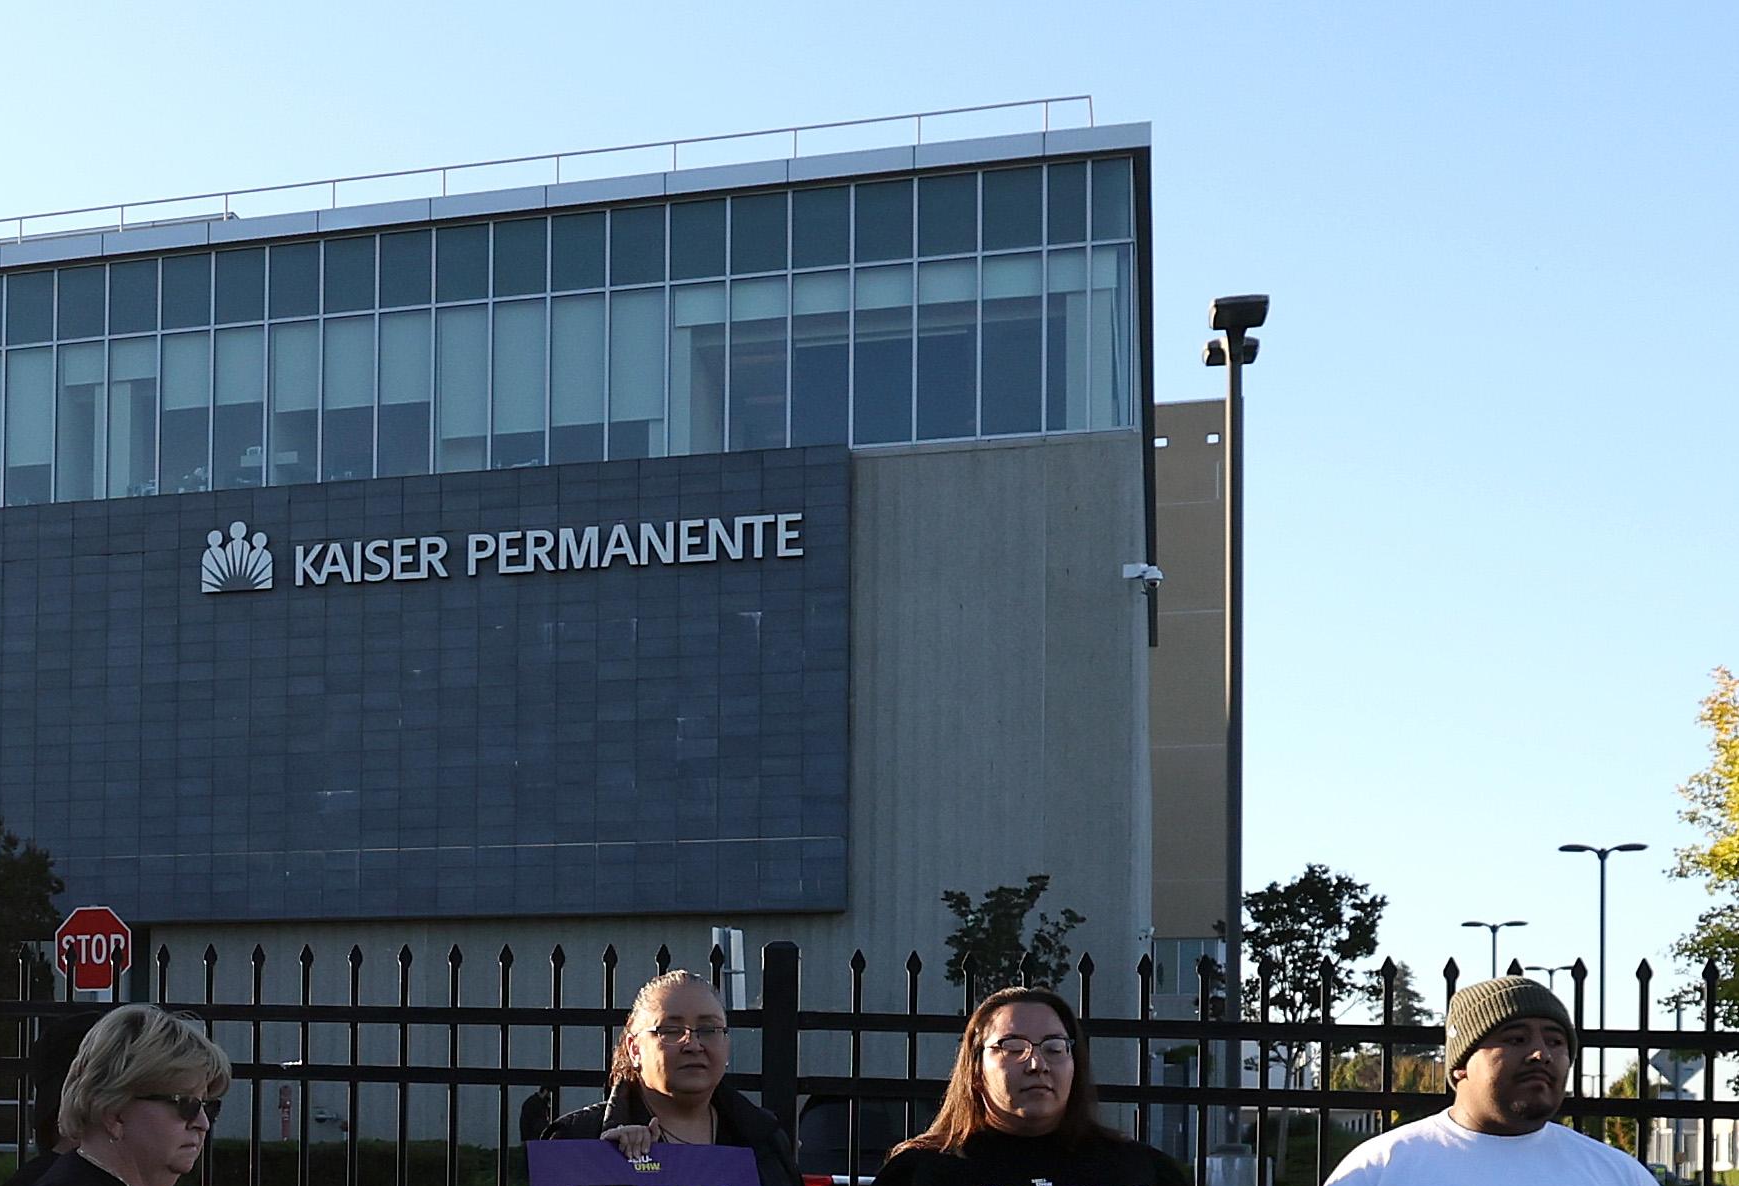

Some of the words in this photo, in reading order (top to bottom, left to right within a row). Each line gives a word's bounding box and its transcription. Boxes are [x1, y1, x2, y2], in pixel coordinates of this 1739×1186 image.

[294, 535, 449, 587] KAISER
[467, 513, 804, 576] PERMANENTE
[62, 933, 125, 965] STOP
